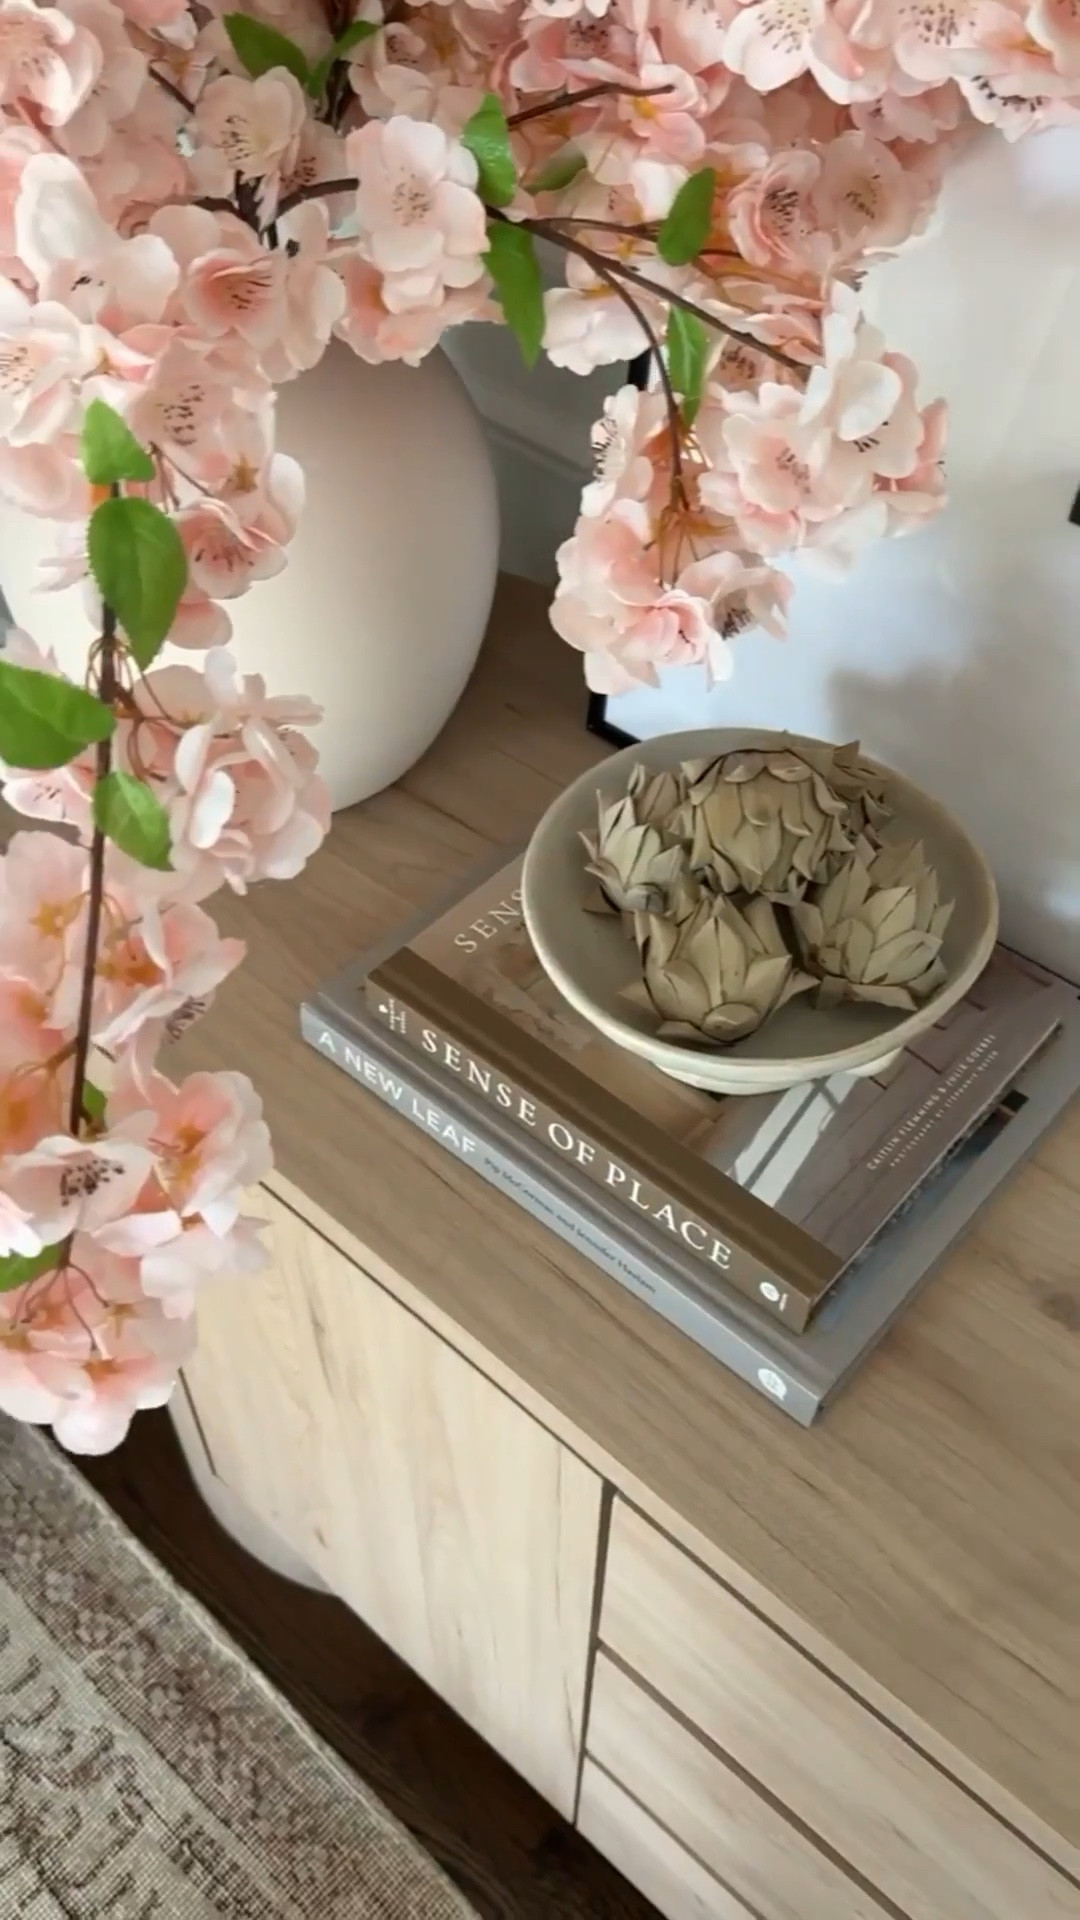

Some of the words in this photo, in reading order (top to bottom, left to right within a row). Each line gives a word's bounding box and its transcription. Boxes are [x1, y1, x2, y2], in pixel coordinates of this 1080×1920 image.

[318, 1031, 336, 1053] A
[344, 1047, 403, 1100] NEW
[412, 1098, 477, 1152] LEAF
[422, 1028, 537, 1126] SENSE
[548, 1122, 596, 1165] OF
[605, 1161, 732, 1269] PLACE
